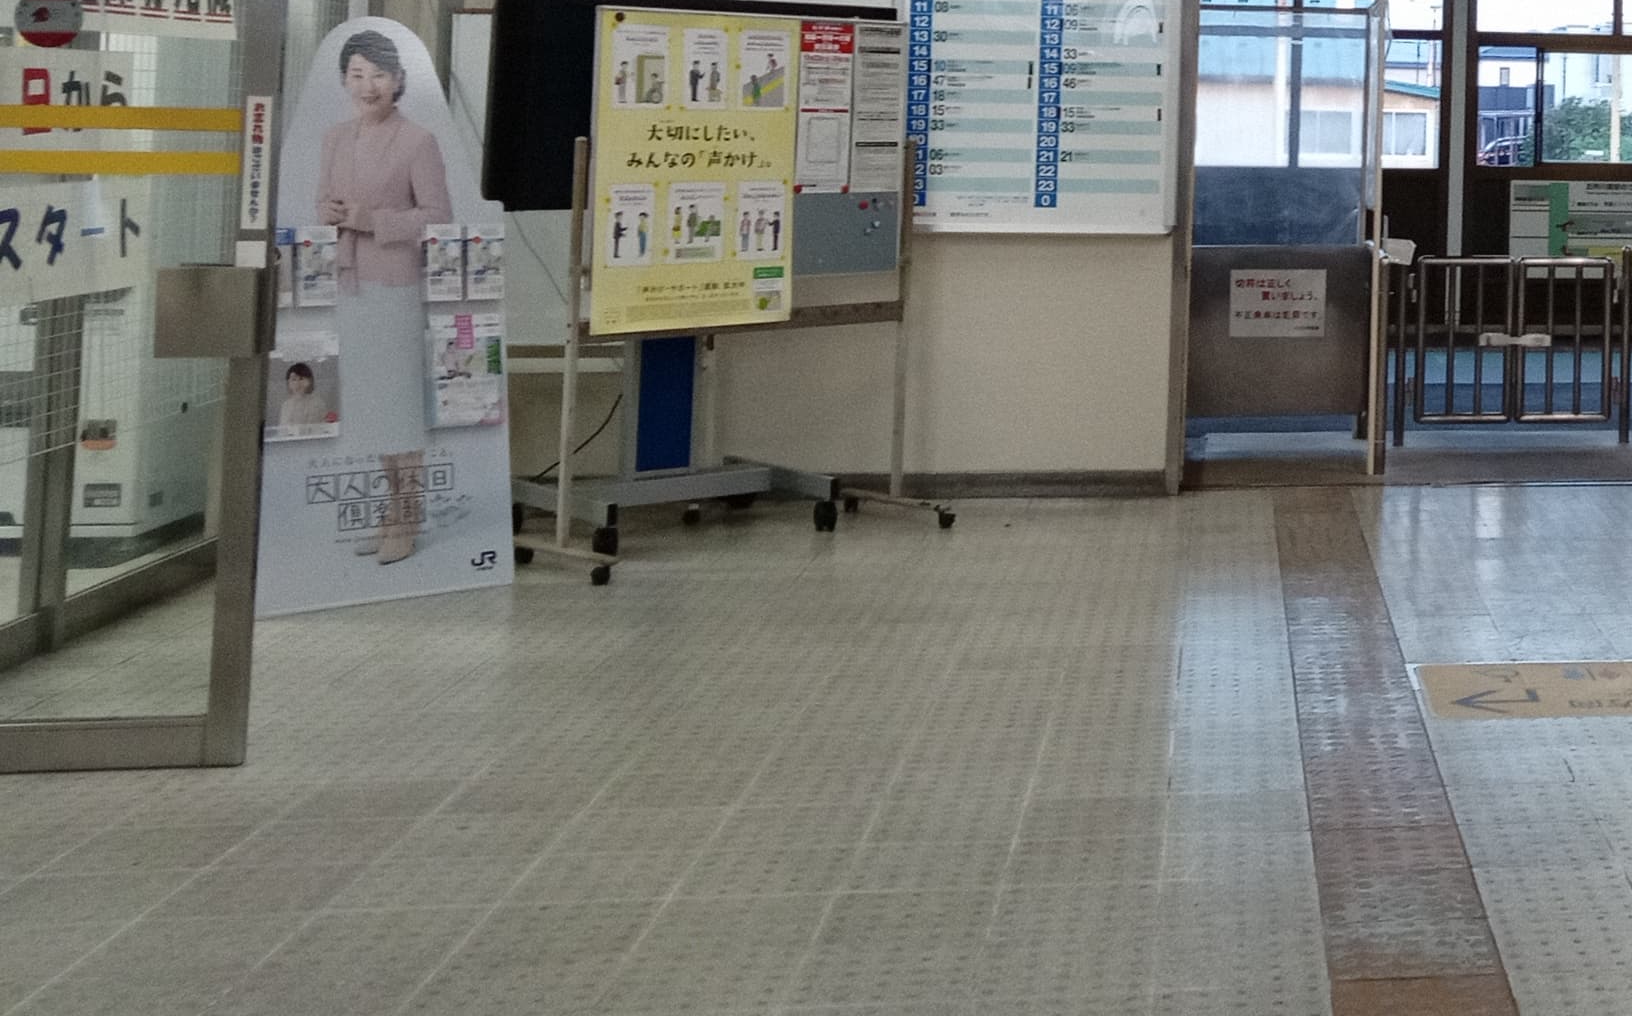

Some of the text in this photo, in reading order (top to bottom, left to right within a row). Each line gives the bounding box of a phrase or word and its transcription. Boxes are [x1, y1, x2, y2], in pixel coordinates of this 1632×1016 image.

[915, 2, 927, 11] 11
[1046, 5, 1057, 15] 11
[915, 17, 928, 27] 12
[1045, 20, 1060, 29] 12
[914, 32, 928, 41] 13
[1044, 35, 1059, 44] 13
[914, 47, 928, 56] 14
[1043, 49, 1059, 58] 14
[913, 61, 928, 70] 15
[1043, 63, 1058, 73] 15
[912, 76, 927, 86] 16
[1043, 78, 1057, 88] 16
[912, 91, 926, 100] 17
[1042, 93, 1055, 102] 17
[912, 105, 945, 116] 18 15
[1042, 108, 1056, 117] 18
[911, 120, 926, 130] 19
[1041, 122, 1055, 132] 19
[1039, 137, 1056, 147] 20
[1039, 151, 1073, 162] 21 21
[1038, 166, 1055, 176] 22
[1038, 180, 1055, 190] 23
[1041, 196, 1050, 206] 0
[471, 551, 496, 567] JR
